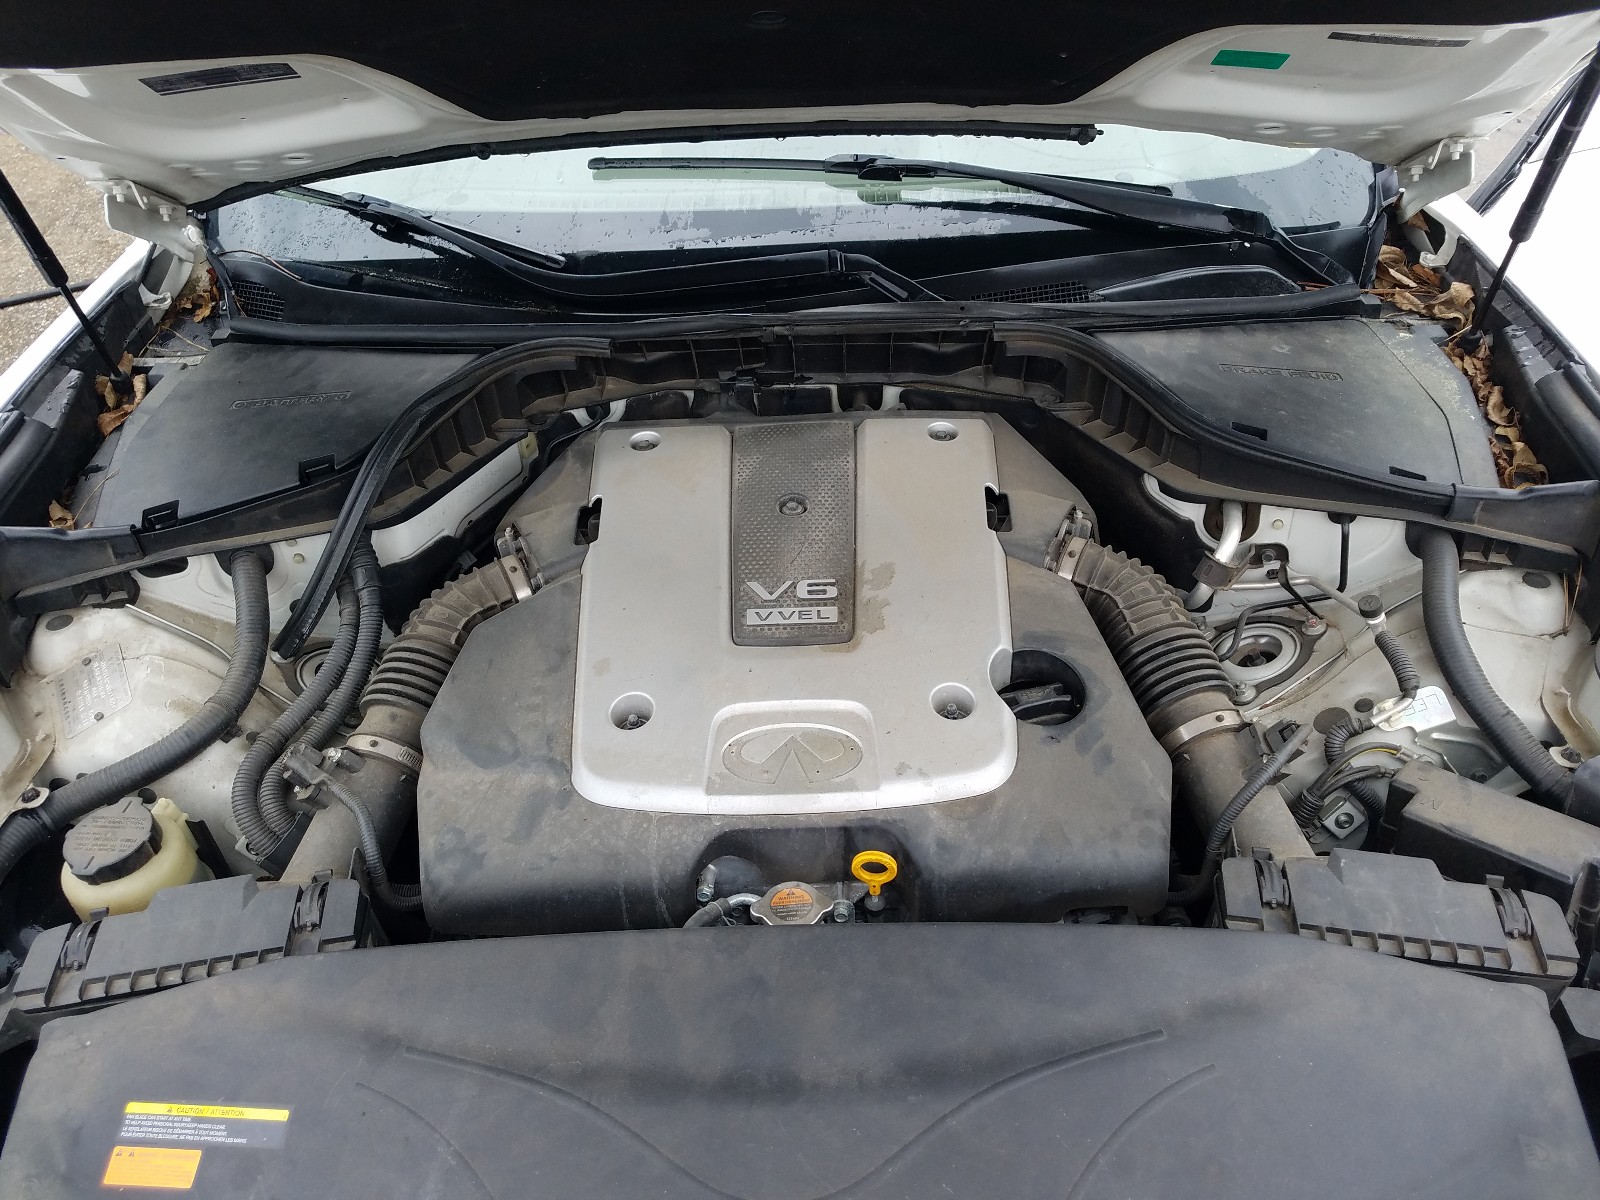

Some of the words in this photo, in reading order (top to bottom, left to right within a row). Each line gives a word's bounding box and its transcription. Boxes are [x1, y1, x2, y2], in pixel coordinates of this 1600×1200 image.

[746, 579, 838, 601] V6
[755, 610, 830, 621] VVEL
[177, 1107, 204, 1115] CAUTION
[210, 1109, 245, 1117] ATTENTION
